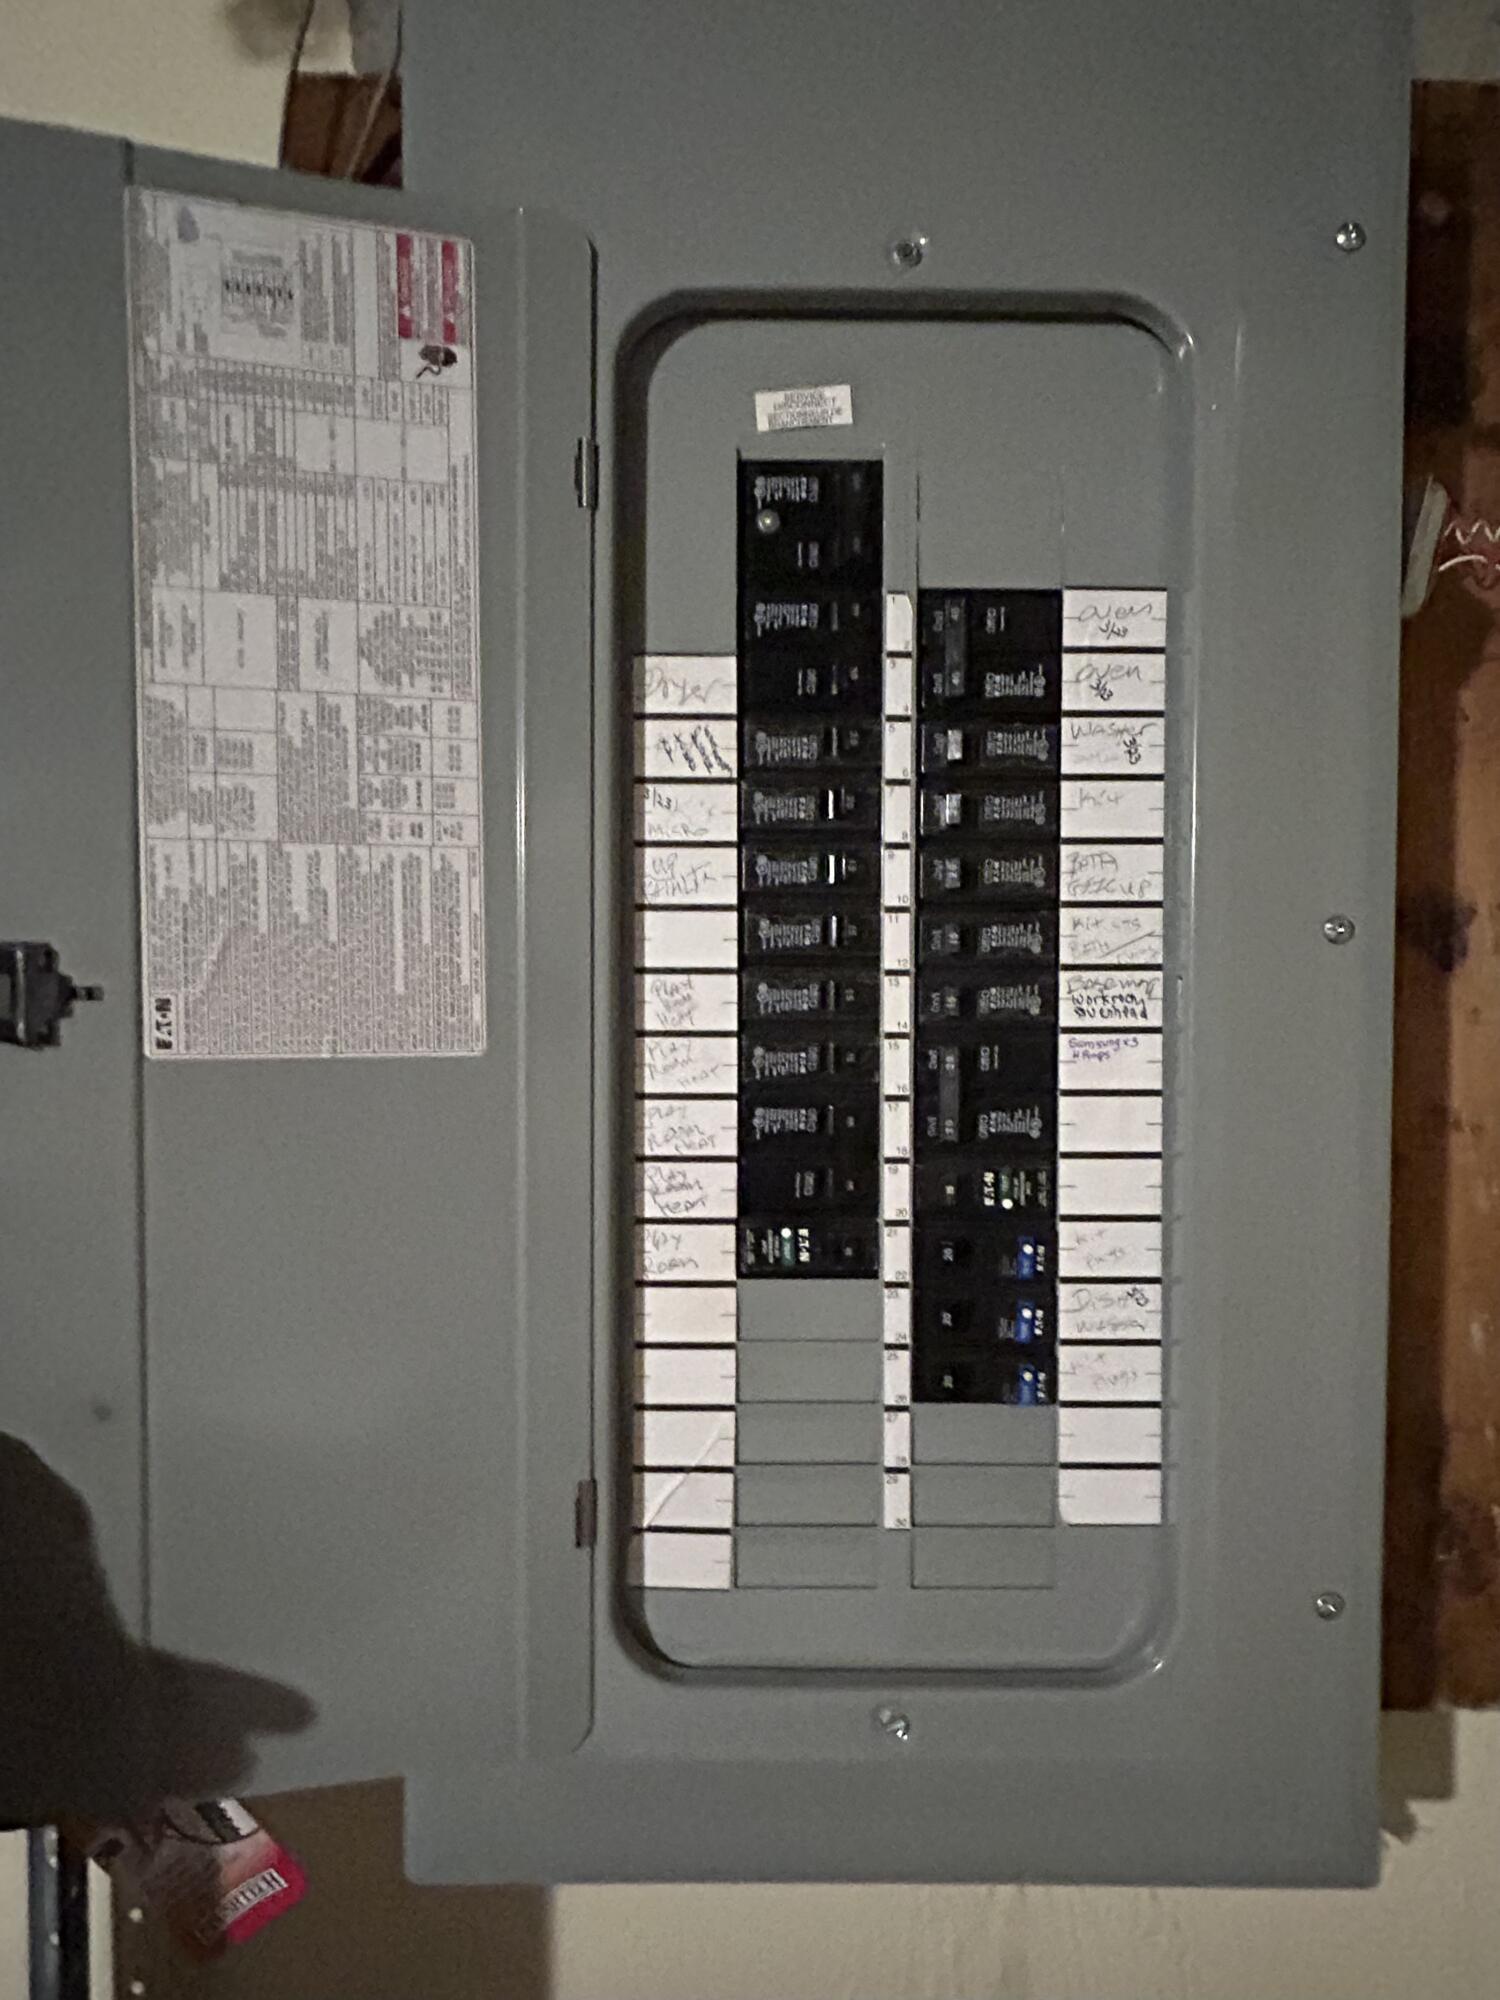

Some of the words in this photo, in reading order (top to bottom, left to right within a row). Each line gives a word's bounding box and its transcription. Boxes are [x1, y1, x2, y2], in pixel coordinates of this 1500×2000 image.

[897, 895, 909, 904] 10
[888, 915, 899, 923] 11
[897, 959, 909, 967] 12
[888, 978, 900, 987] 13
[155, 998, 173, 1050] EATON
[897, 1021, 908, 1030] 14
[888, 1042, 900, 1050] 15
[897, 1084, 908, 1092] 16
[888, 1104, 899, 1112] 17
[897, 1147, 908, 1155] 18
[888, 1166, 898, 1174] 19
[896, 1209, 907, 1217] 20
[895, 1333, 907, 1342] 24
[887, 1352, 899, 1360] 25
[895, 1394, 907, 1403] 26
[887, 1413, 898, 1422] 27
[887, 1475, 898, 1484] 29
[895, 1518, 907, 1527] 30
